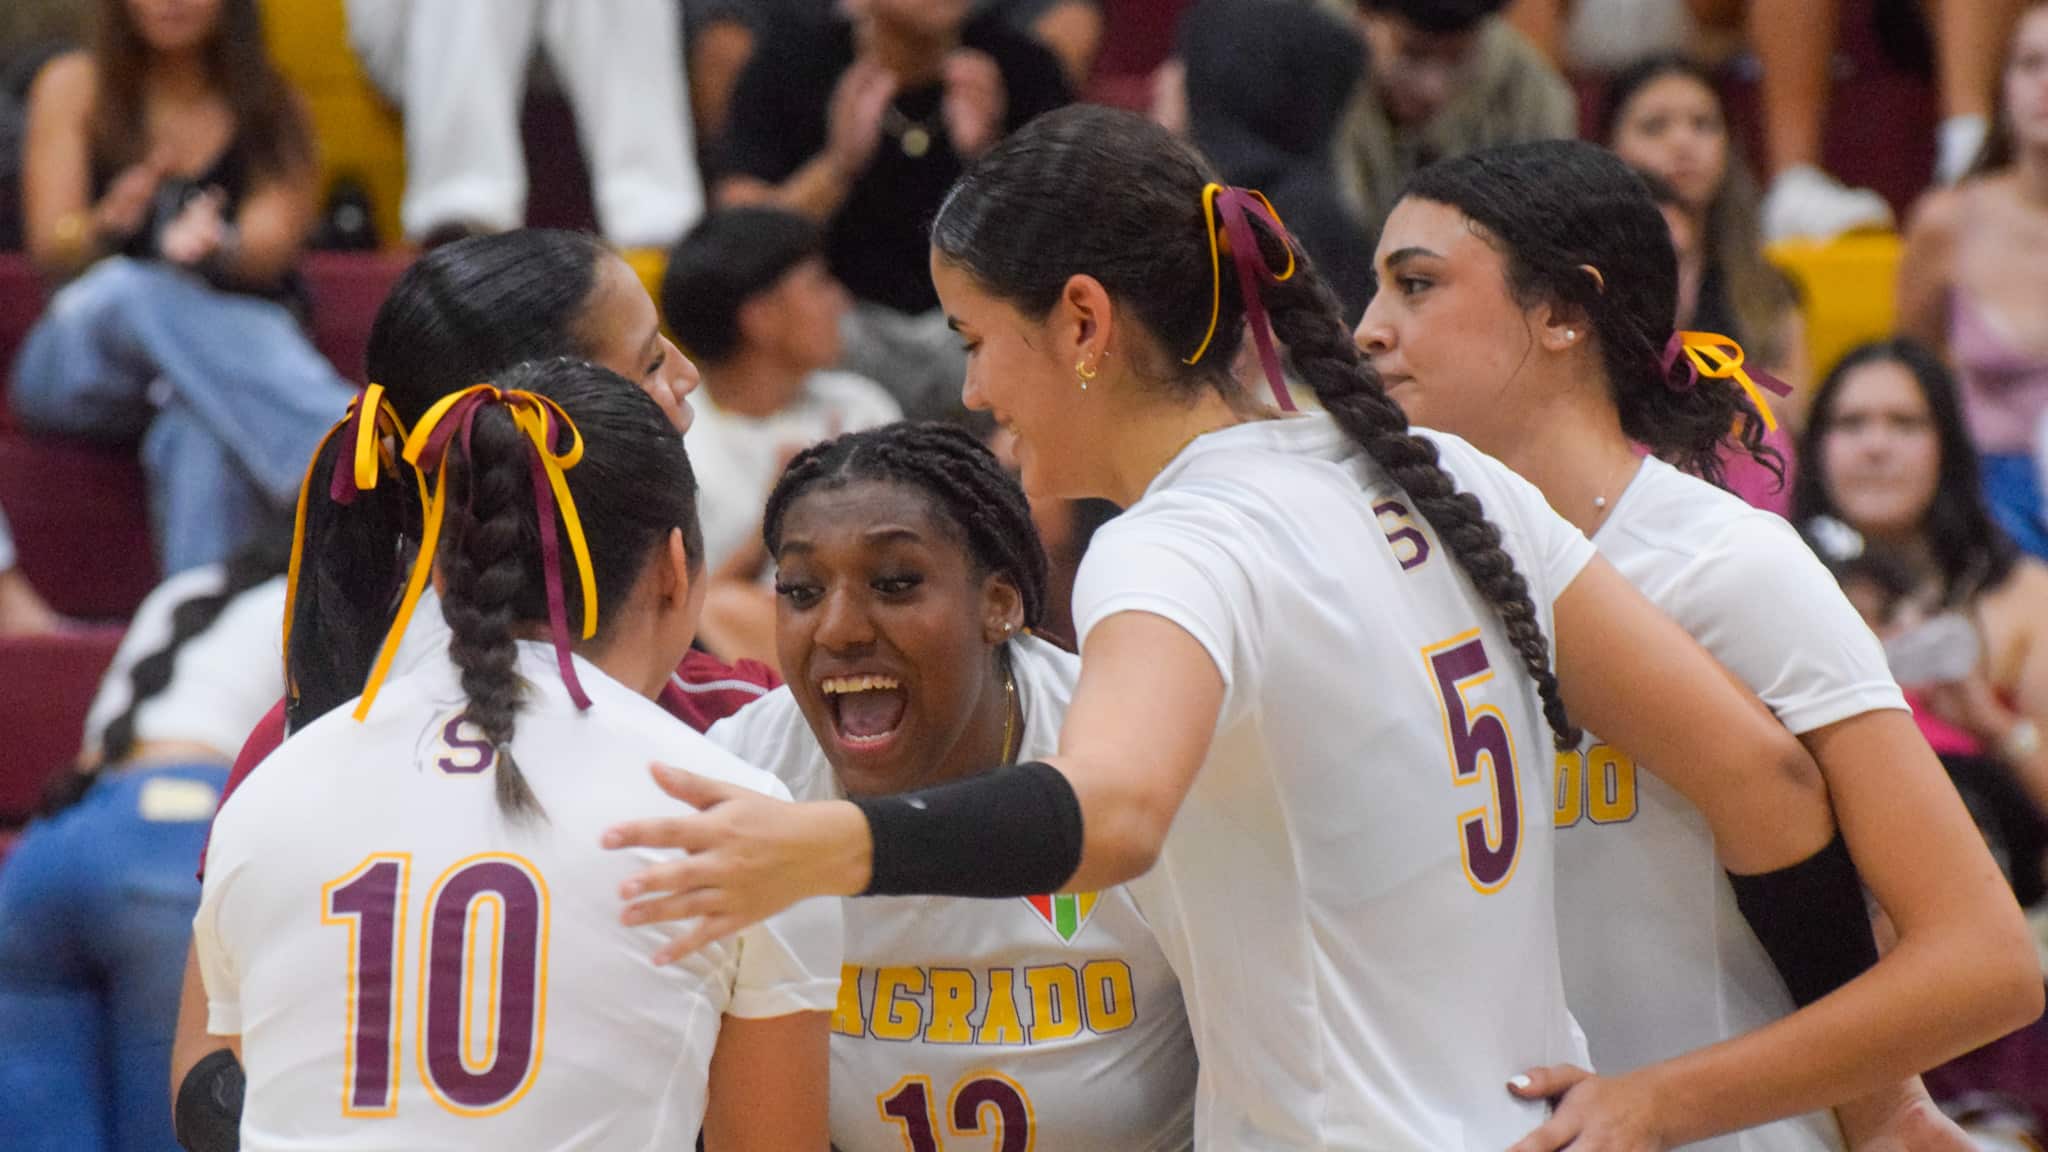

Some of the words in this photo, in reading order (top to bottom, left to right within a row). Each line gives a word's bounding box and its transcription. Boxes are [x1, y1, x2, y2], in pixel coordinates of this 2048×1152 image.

[433, 708, 496, 778] S
[1421, 627, 1523, 895] 5
[321, 851, 552, 1118] 10
